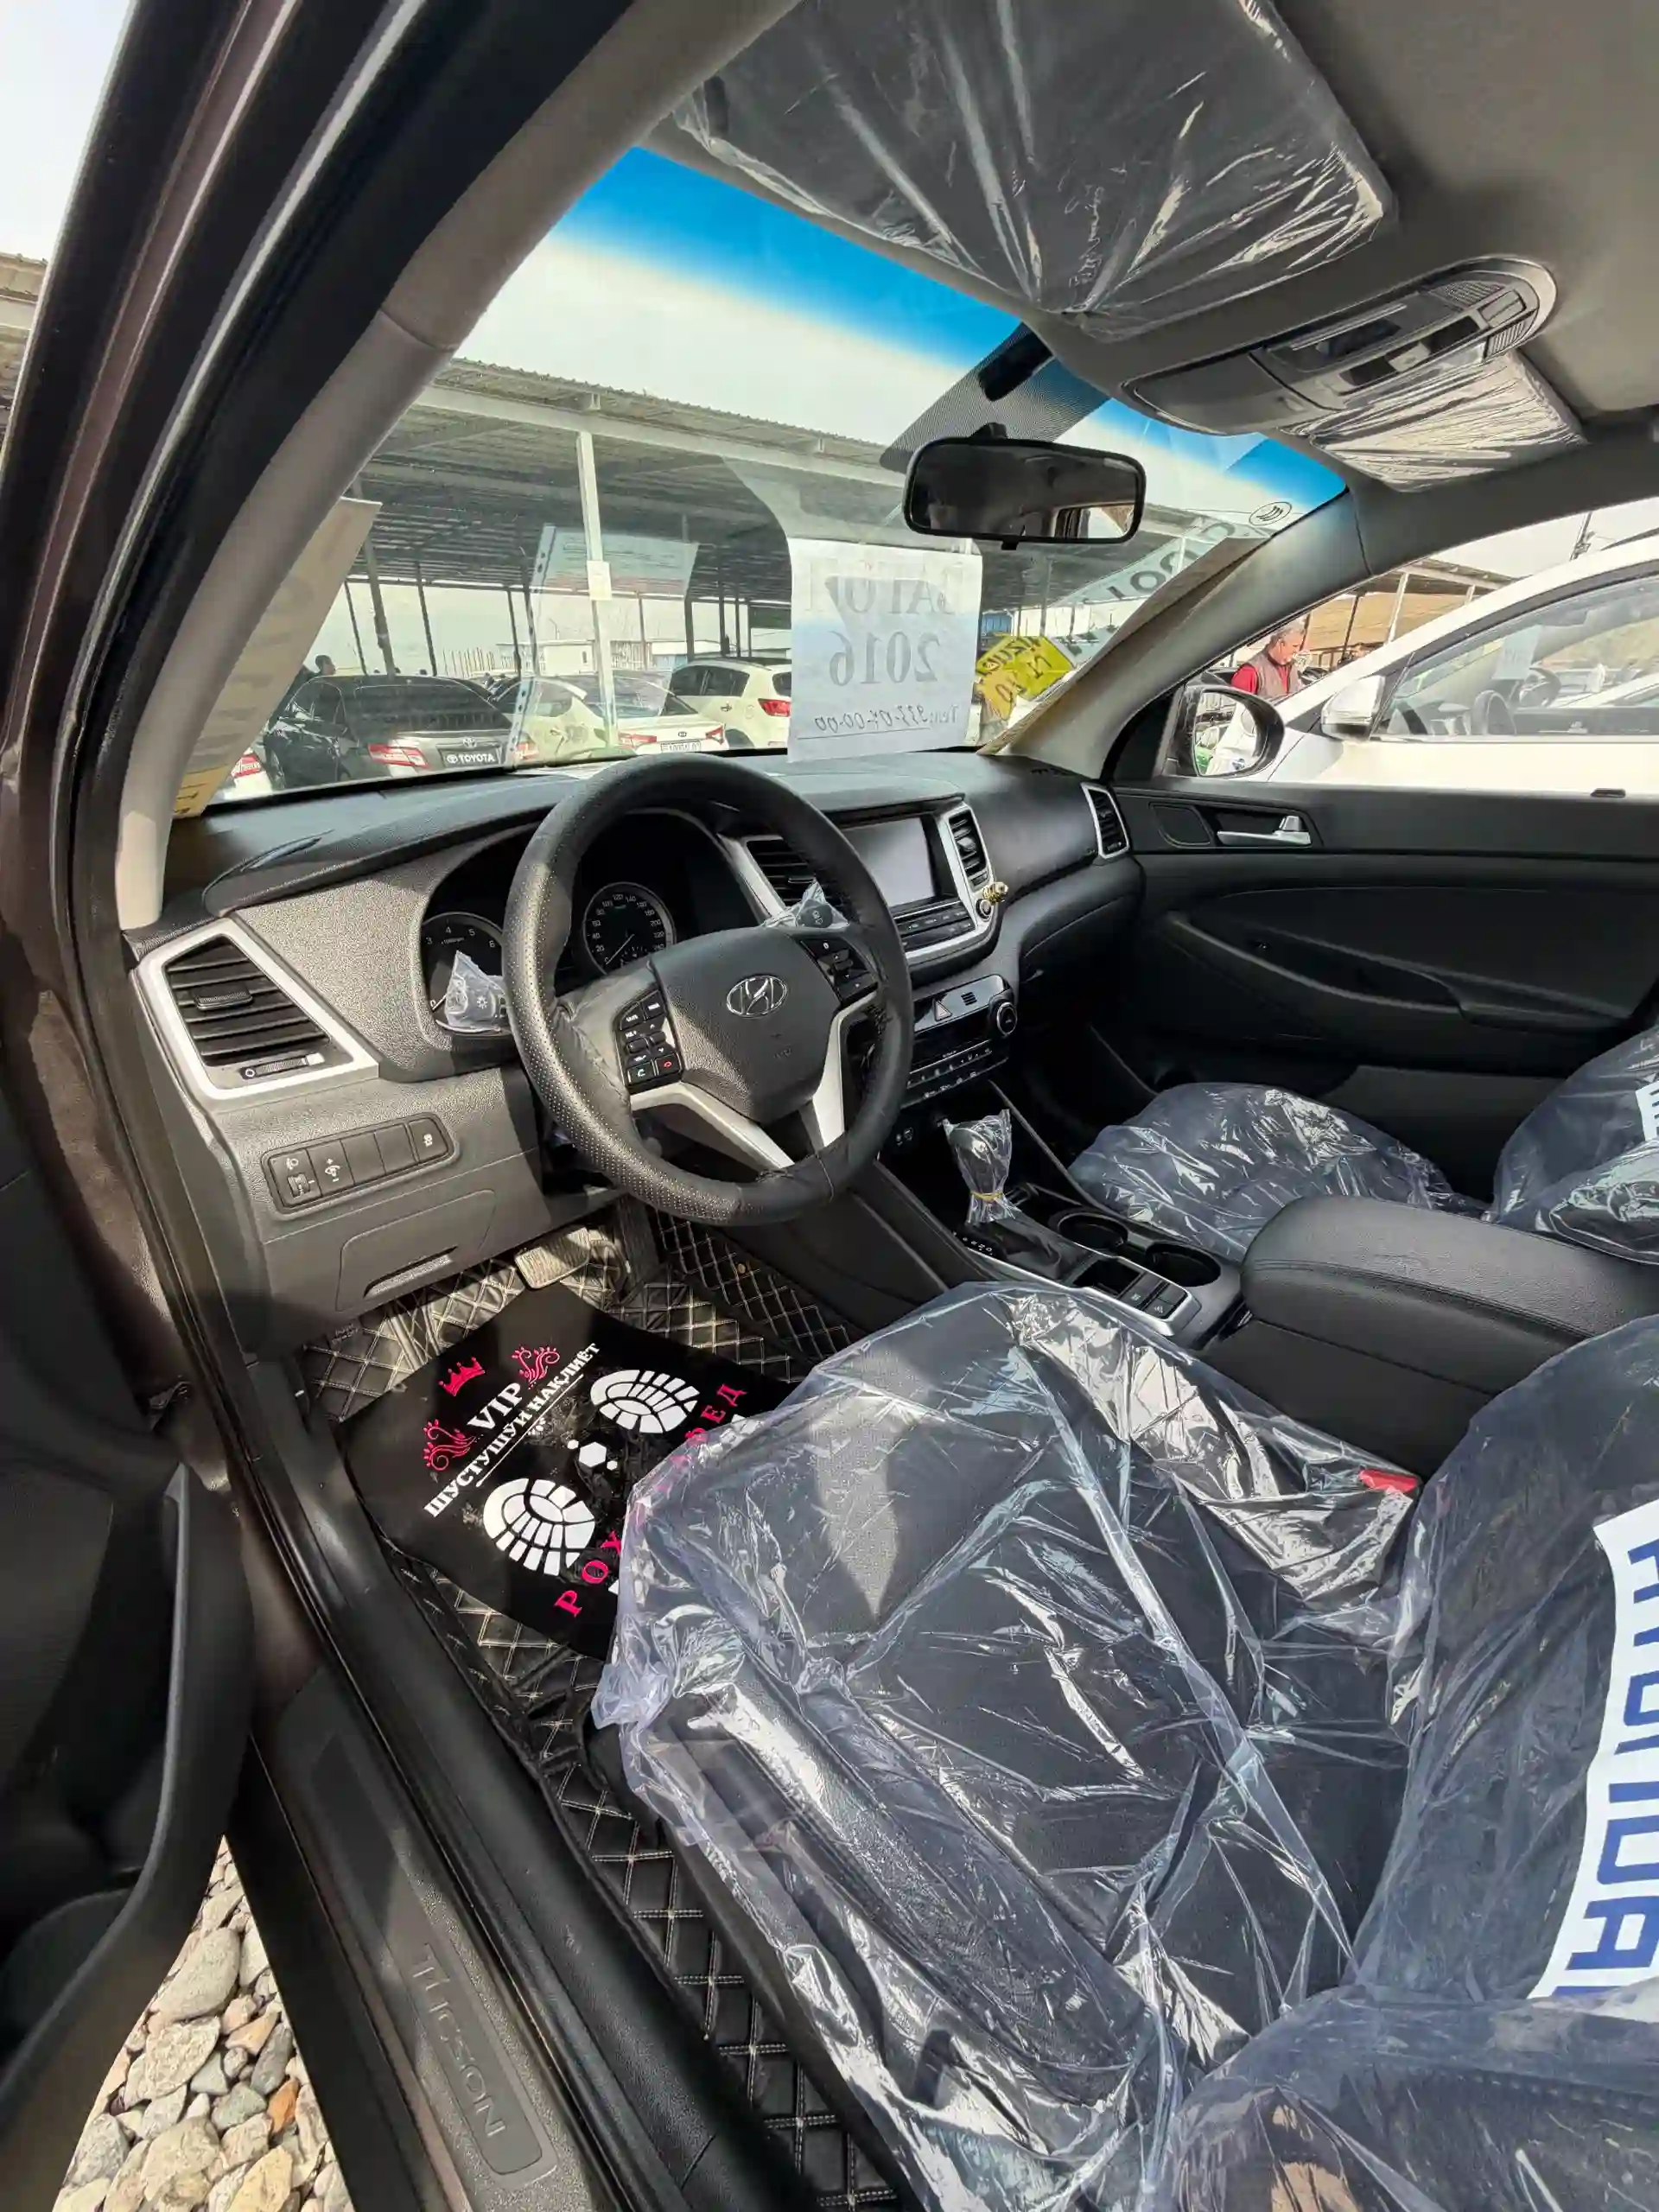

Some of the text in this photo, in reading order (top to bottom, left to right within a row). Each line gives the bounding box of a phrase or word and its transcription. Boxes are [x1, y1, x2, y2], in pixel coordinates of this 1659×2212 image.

[458, 753, 495, 765] TOYOTA
[467, 1382, 523, 1430] VIP
[412, 1943, 506, 2138] TUCSON
